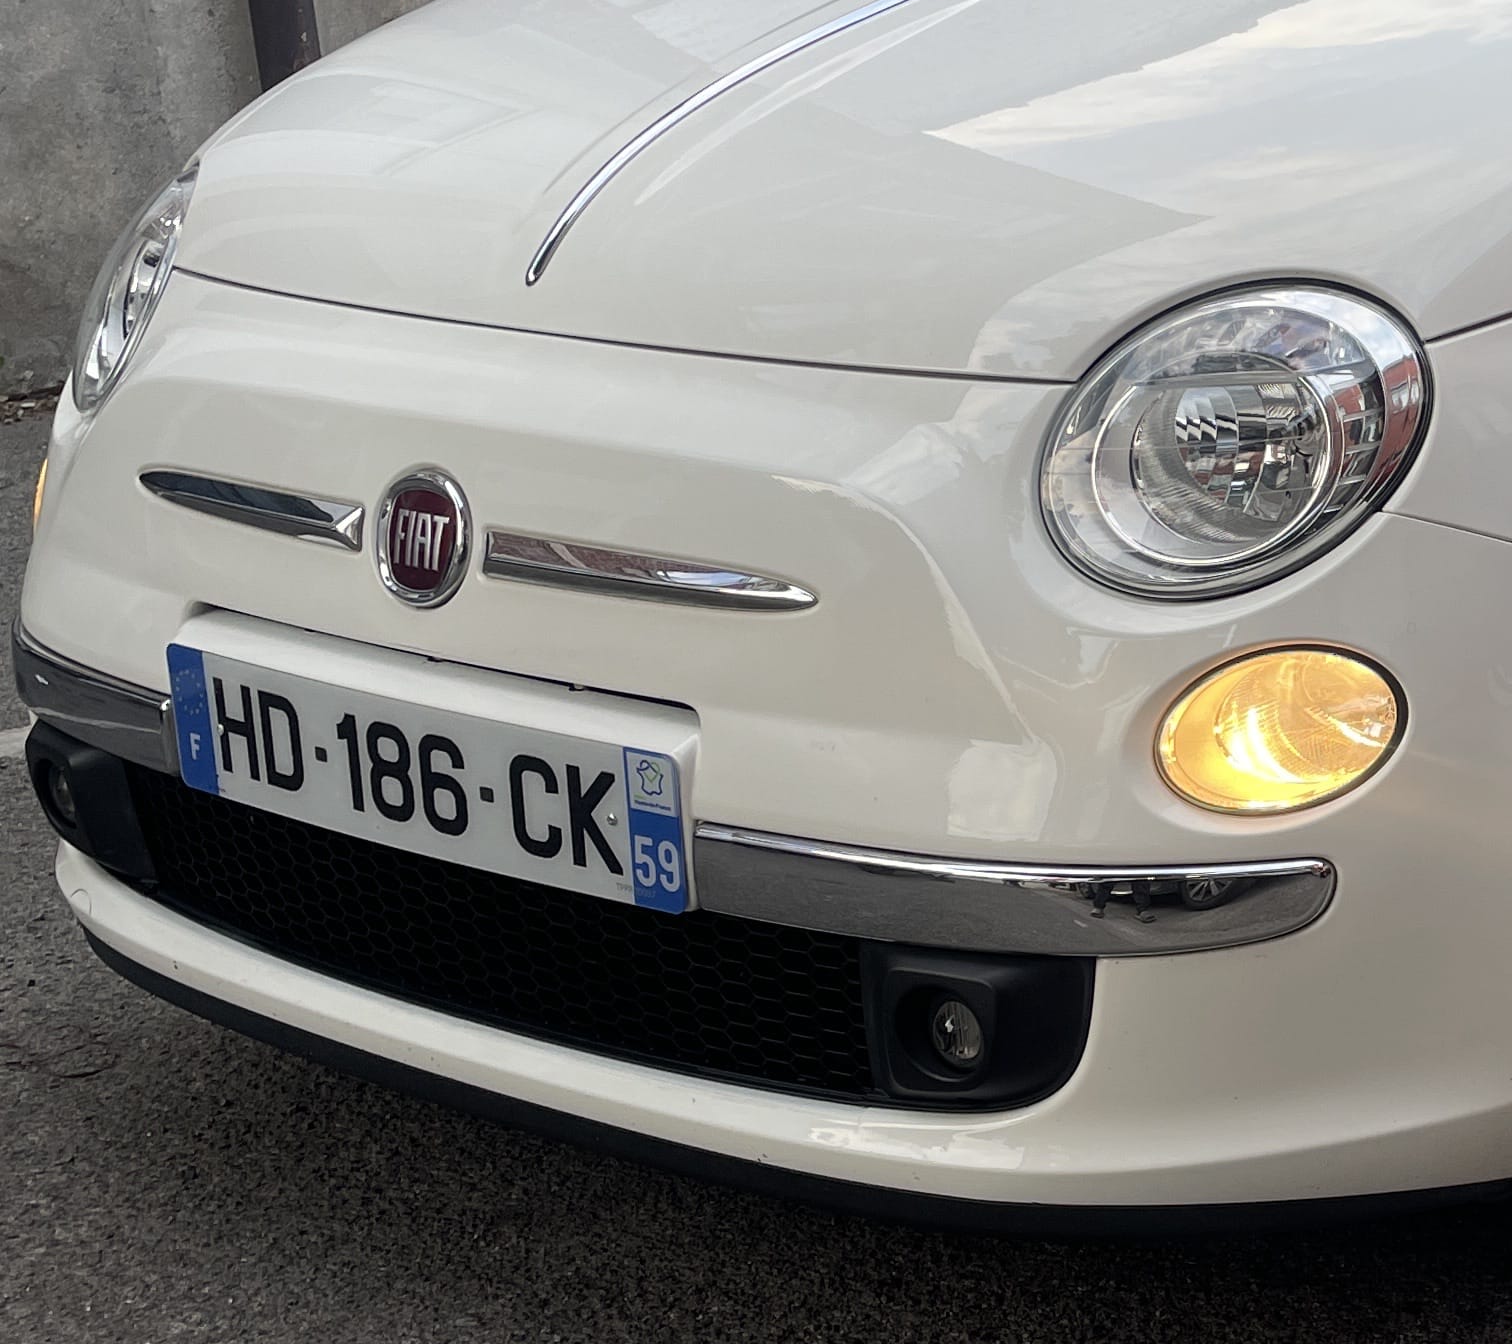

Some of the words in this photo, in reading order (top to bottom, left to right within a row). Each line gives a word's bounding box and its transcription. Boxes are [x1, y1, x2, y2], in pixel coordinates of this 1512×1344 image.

[394, 508, 450, 571] FIAT
[189, 732, 201, 761] F
[634, 834, 680, 893] 59
